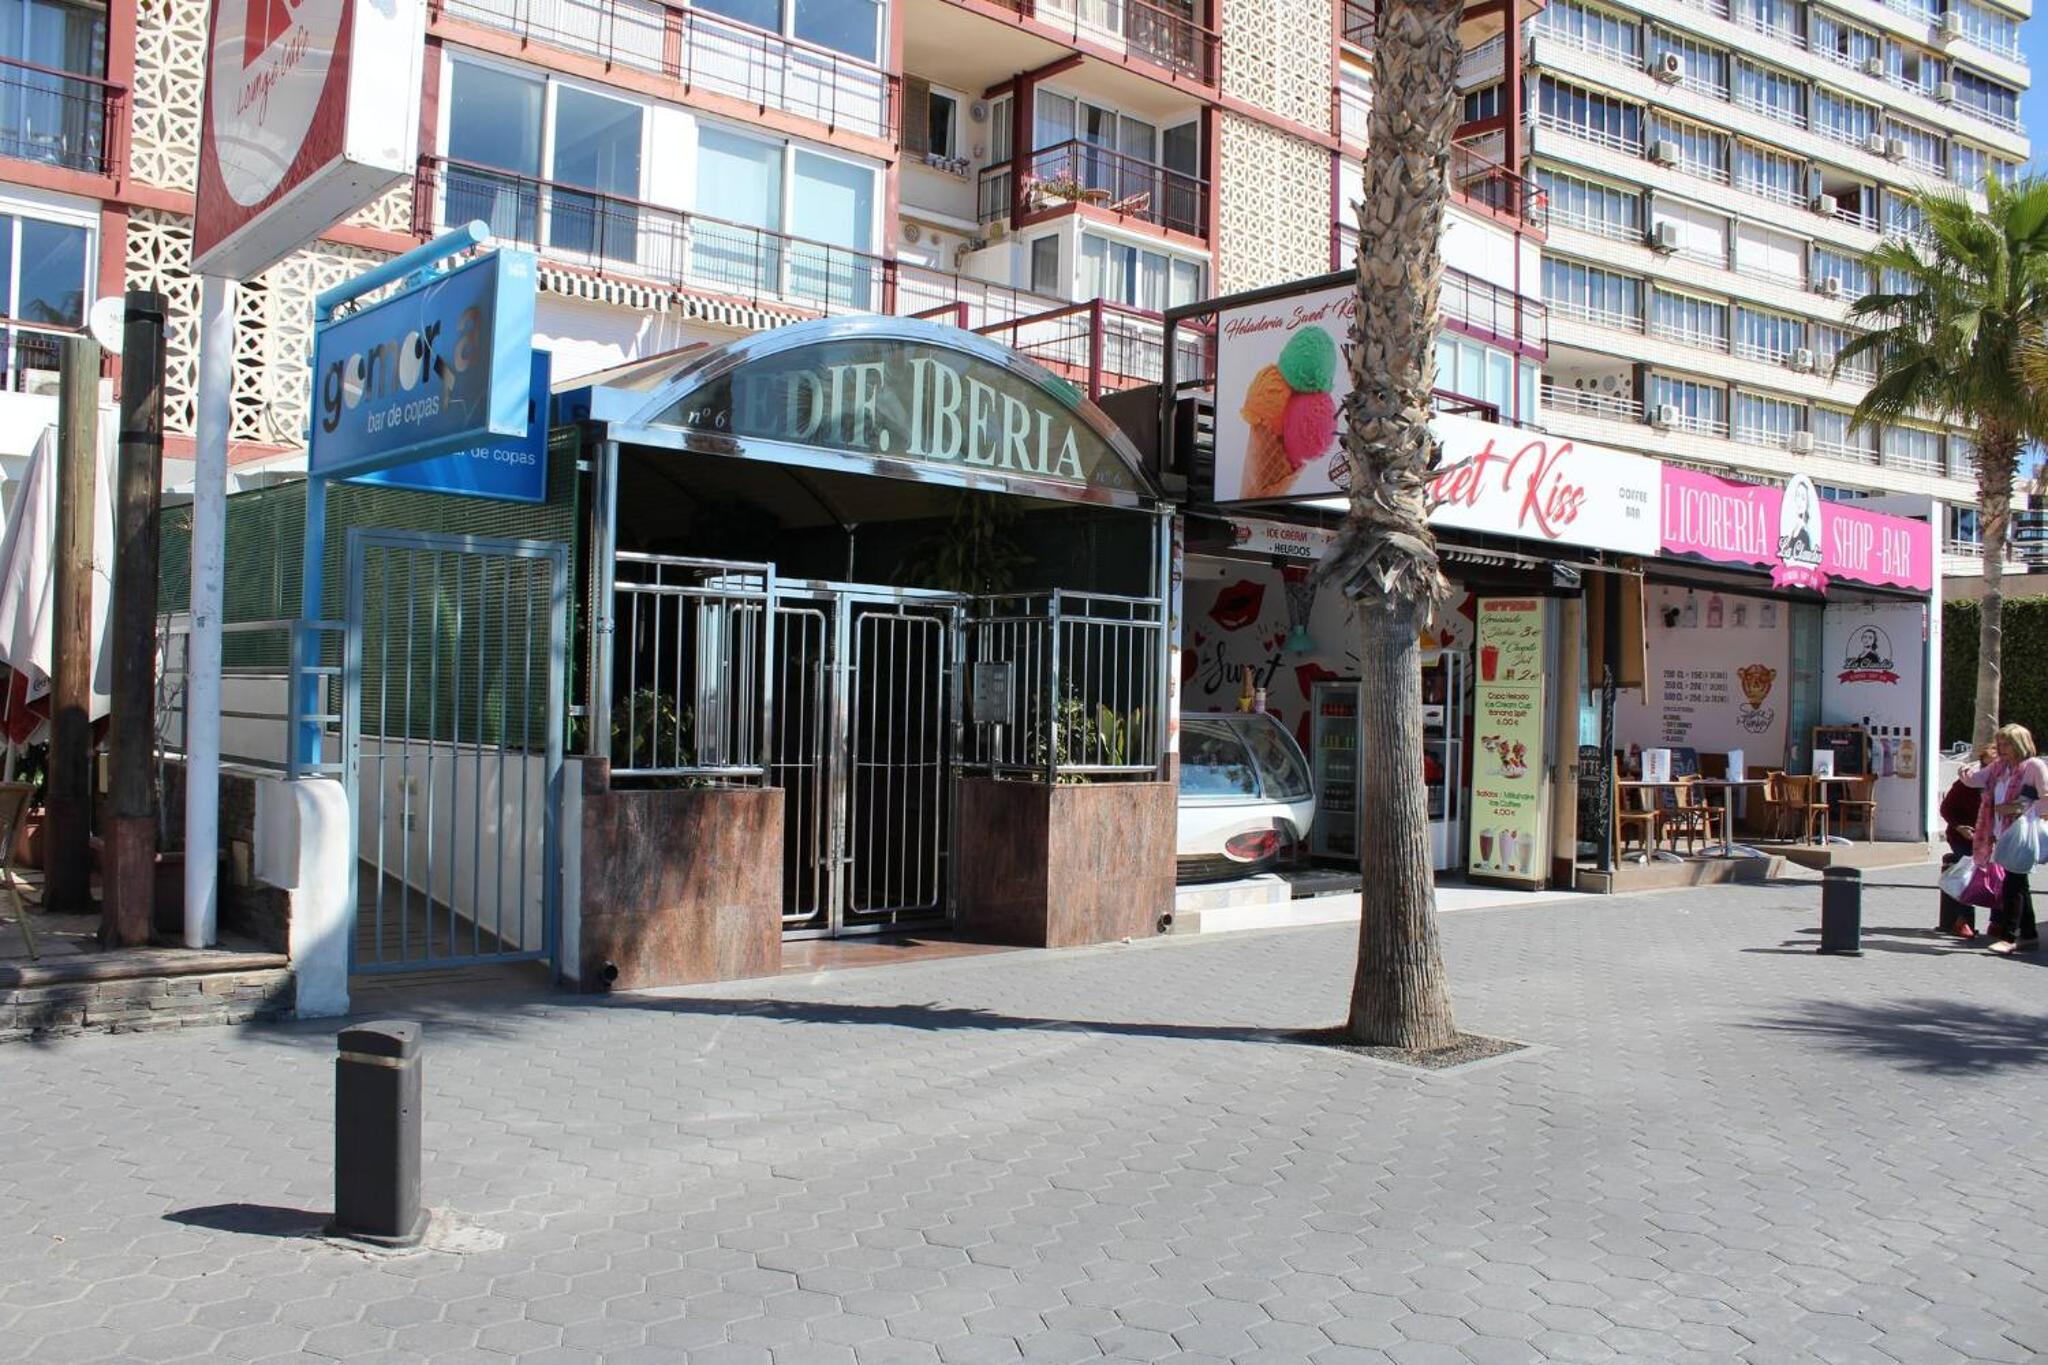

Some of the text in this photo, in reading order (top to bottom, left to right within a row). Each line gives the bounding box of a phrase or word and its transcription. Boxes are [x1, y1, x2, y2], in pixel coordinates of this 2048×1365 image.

[237, 60, 278, 127] Lounge
[1286, 302, 1332, 330] Sweet
[368, 395, 440, 433] bar de copas
[714, 409, 729, 428] 6
[906, 358, 1087, 480] IBERIA
[493, 449, 536, 465] copas
[1502, 440, 1588, 539] Kiss
[1618, 486, 1648, 503] COFFEE
[1266, 527, 1279, 539] ICE
[1280, 529, 1308, 542] CREAM
[1663, 482, 1768, 556] LICORERÍA
[1274, 542, 1311, 557] HELADOS
[1832, 515, 1874, 572] SHOP
